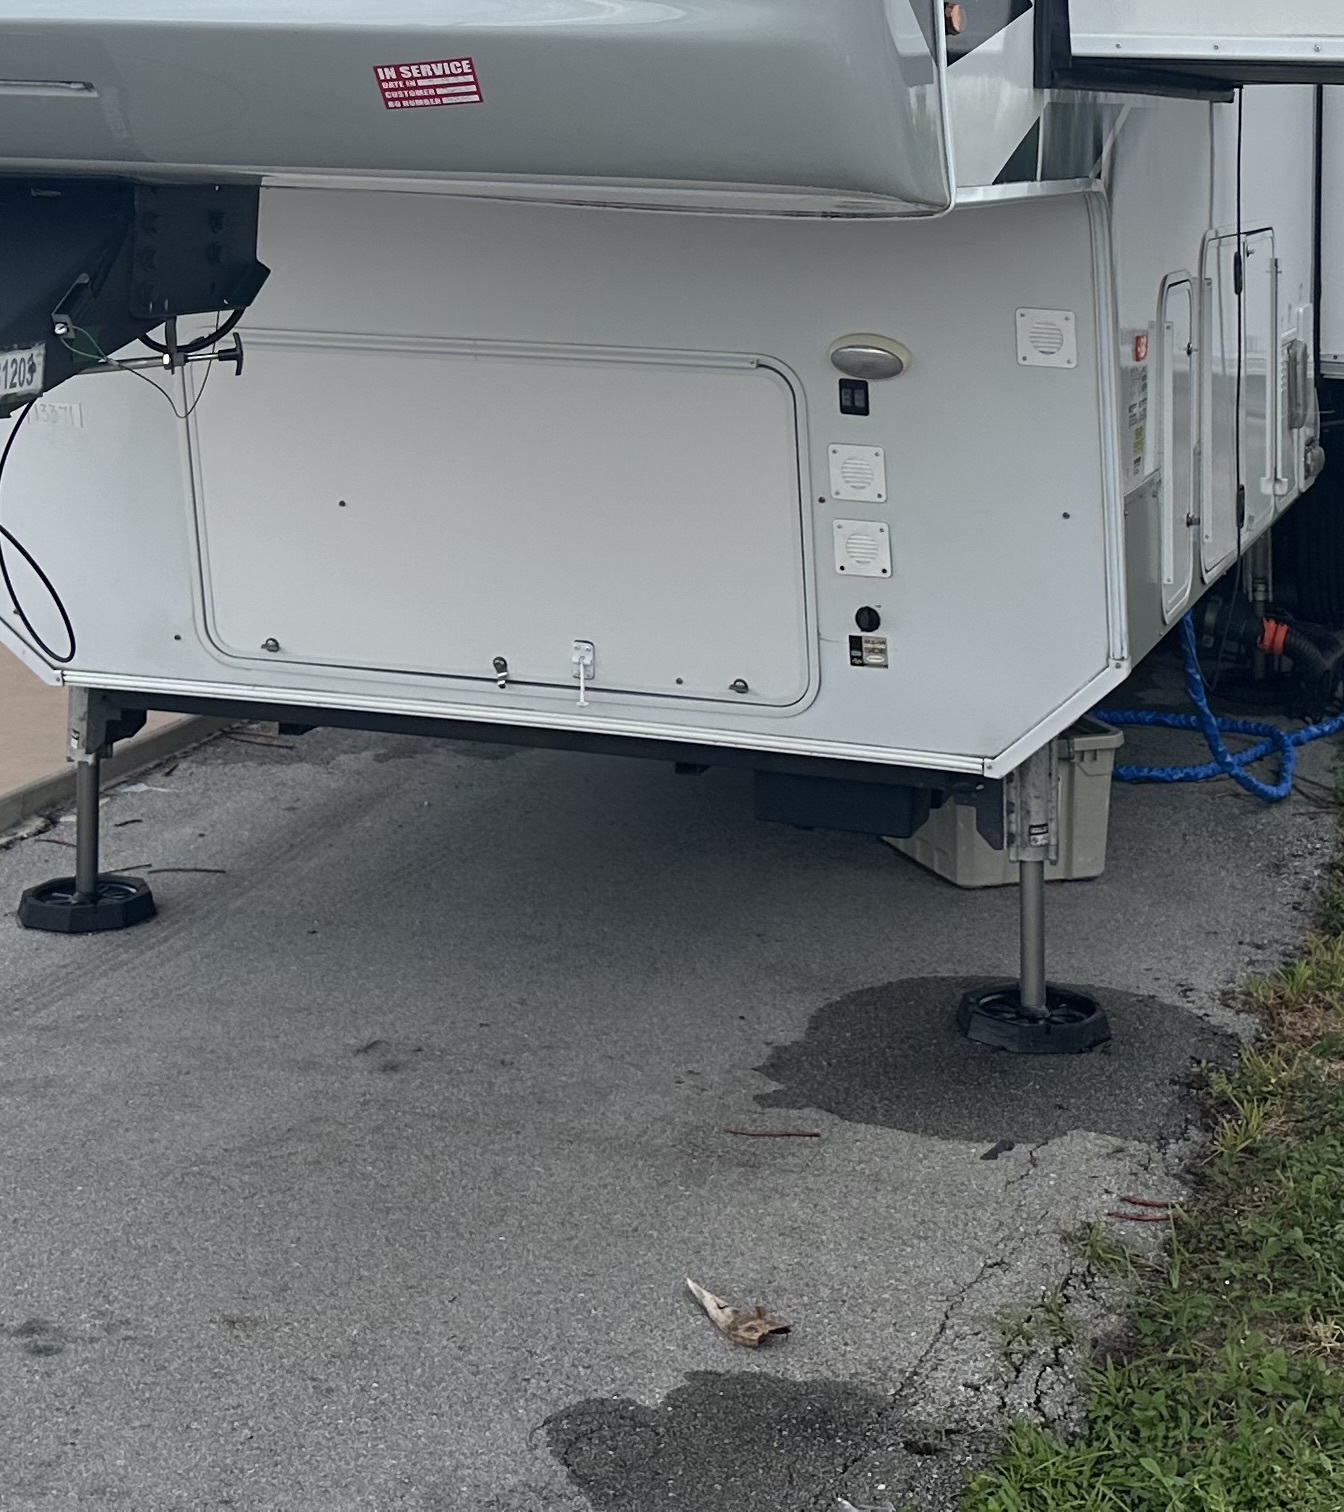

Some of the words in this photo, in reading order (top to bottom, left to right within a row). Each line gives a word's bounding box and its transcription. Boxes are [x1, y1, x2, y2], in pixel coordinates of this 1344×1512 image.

[377, 67, 397, 80] IN
[399, 60, 473, 78] SERVICE
[382, 80, 404, 89] DATE
[385, 88, 435, 98] CUSTOMER
